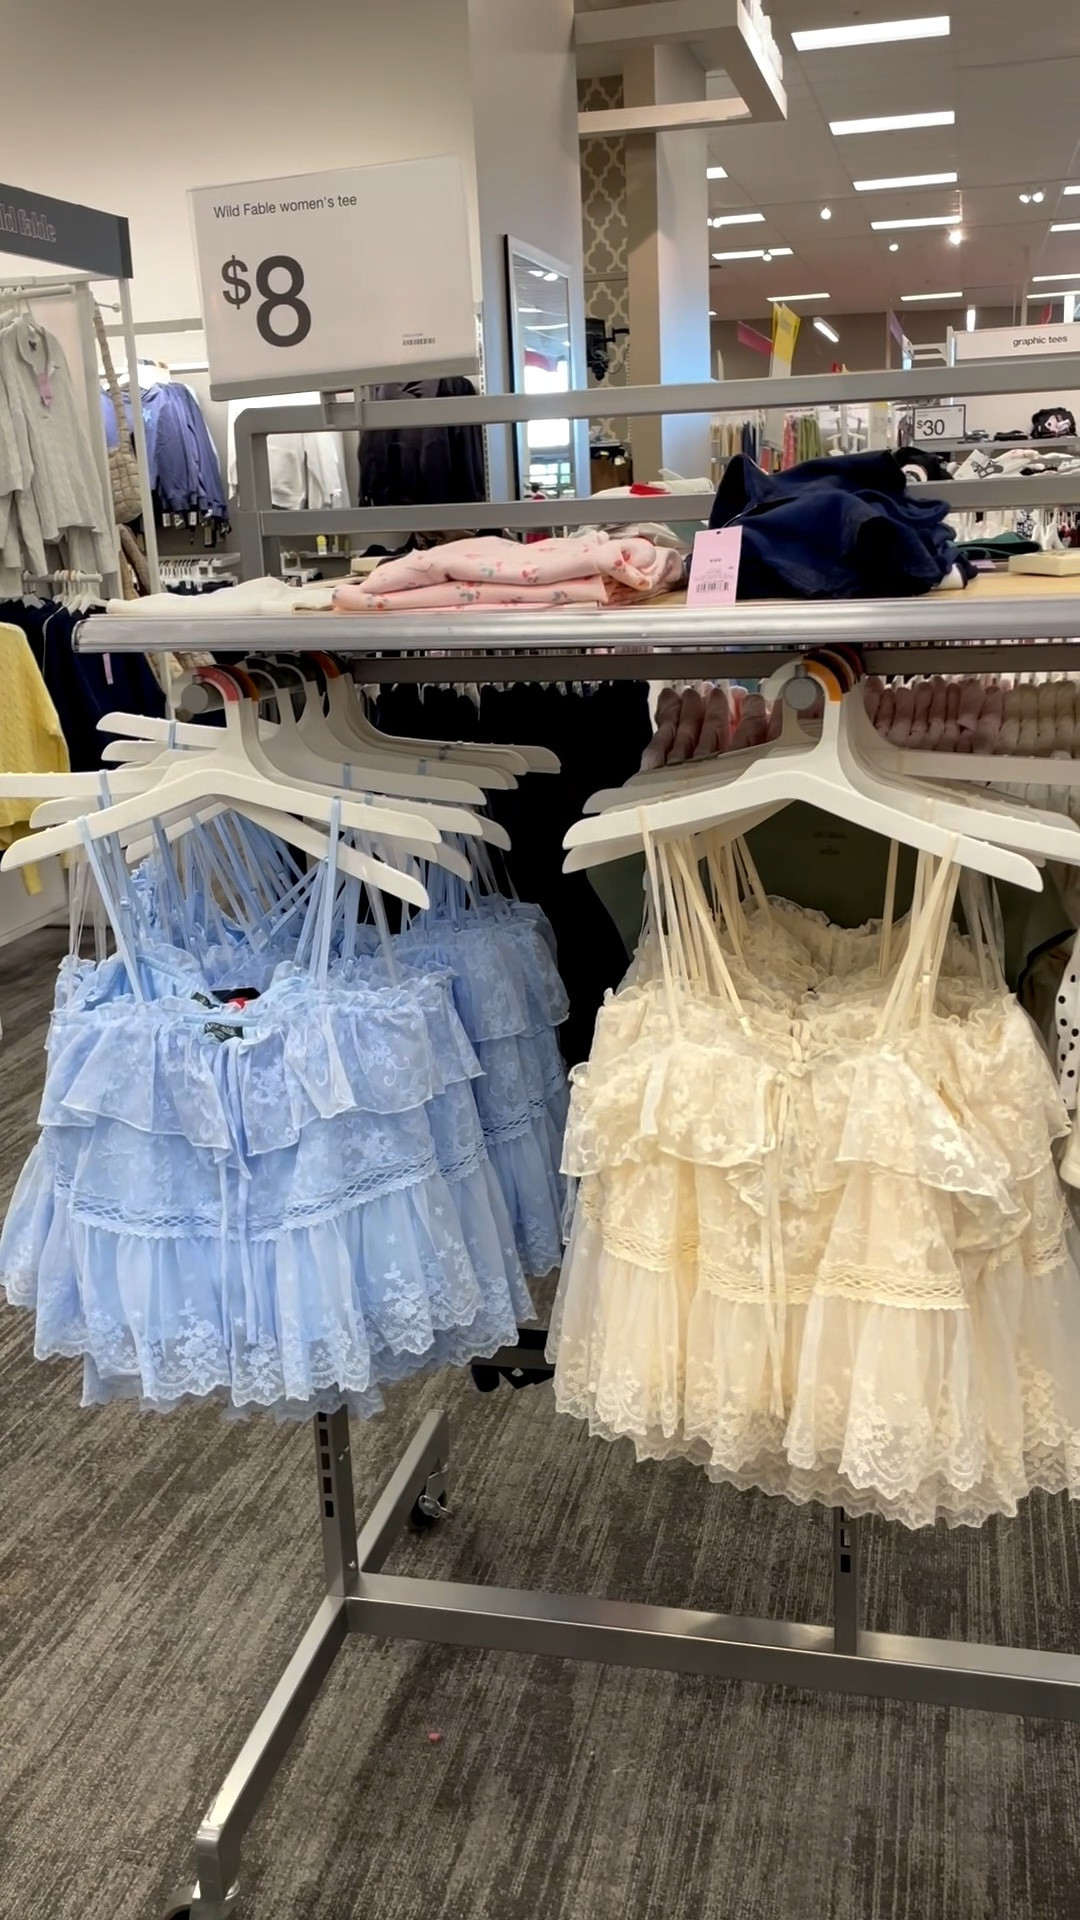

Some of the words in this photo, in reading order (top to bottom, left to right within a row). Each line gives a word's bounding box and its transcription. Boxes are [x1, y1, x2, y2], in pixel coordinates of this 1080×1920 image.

[213, 204, 240, 219] Wild
[243, 202, 276, 216] Fable
[279, 196, 335, 212] women's
[337, 195, 357, 207] tee
[222, 255, 311, 347] $8
[1012, 336, 1046, 348] graphic
[1048, 335, 1068, 344] tees
[916, 418, 945, 437] $30
